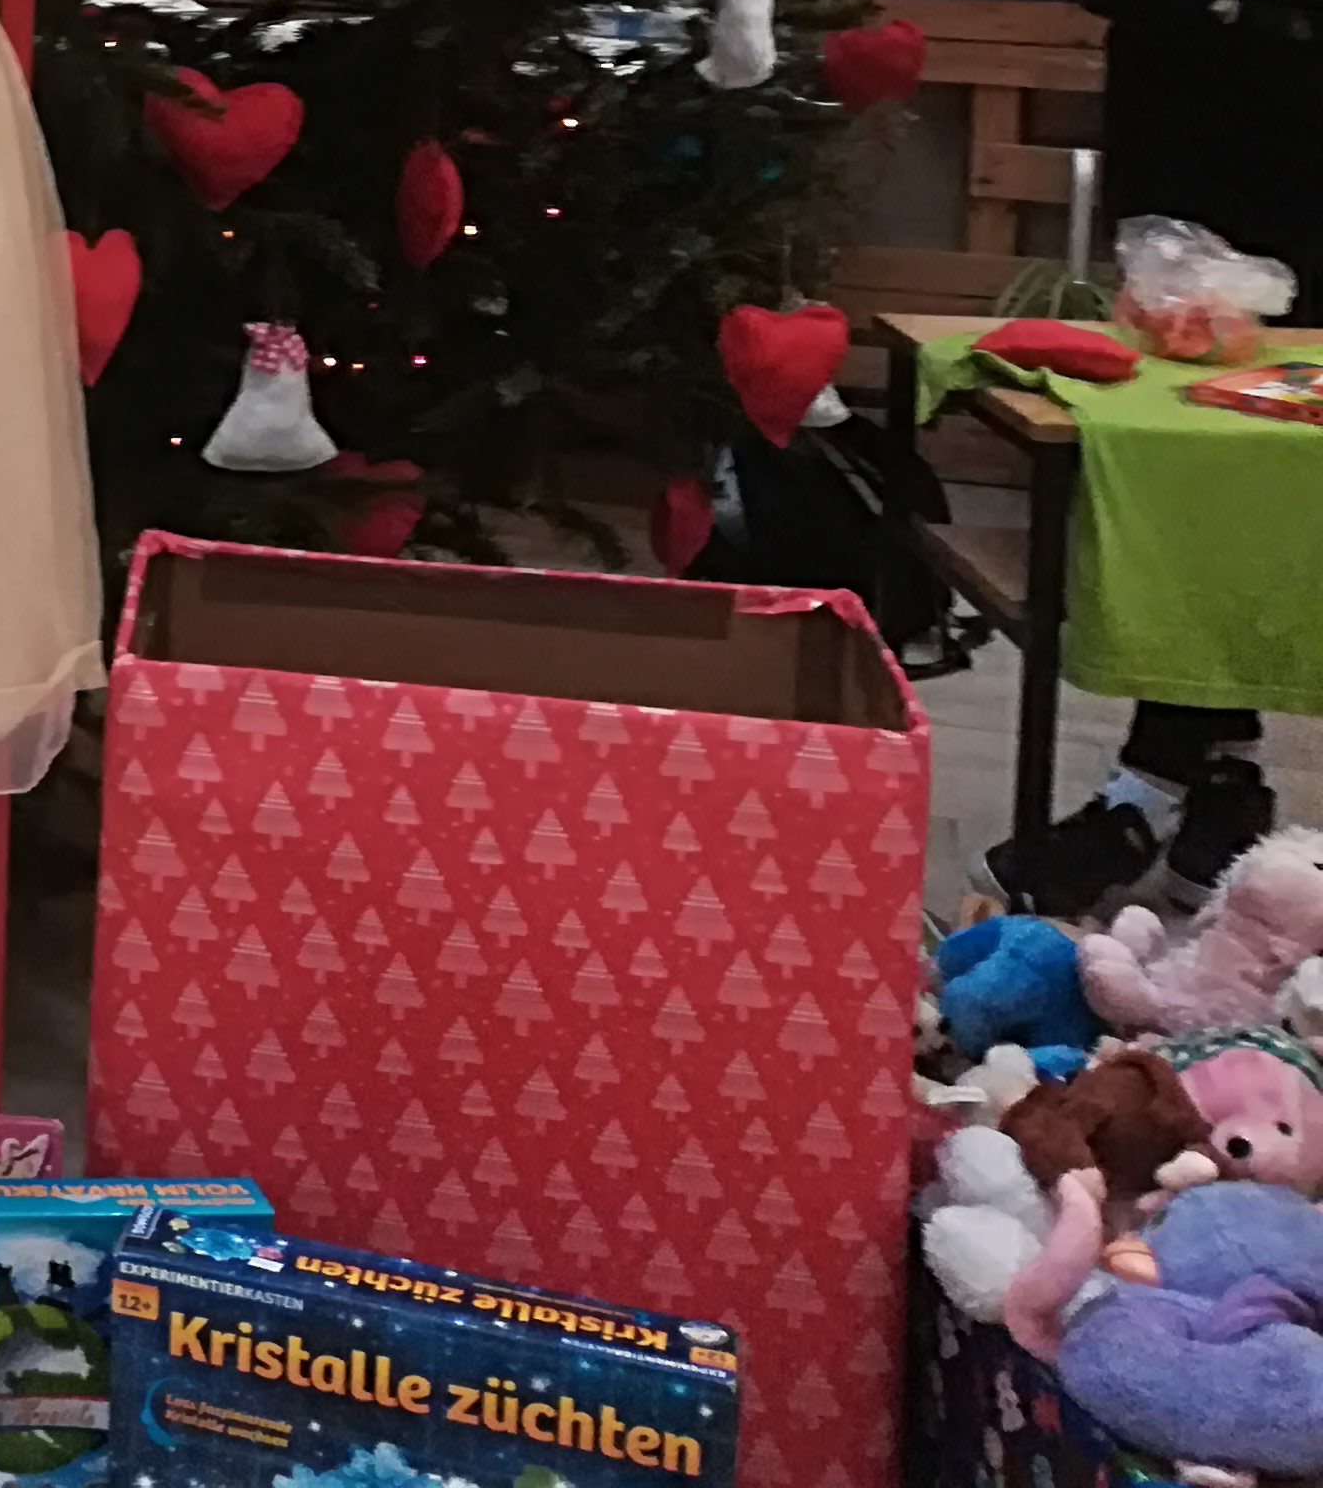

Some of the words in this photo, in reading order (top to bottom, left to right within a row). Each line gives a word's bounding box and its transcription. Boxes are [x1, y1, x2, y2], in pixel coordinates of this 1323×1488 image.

[118, 1261, 305, 1311] EXPERIMENTIERKASTEN
[118, 1294, 153, 1313] 12+
[296, 1254, 464, 1304] züchten
[472, 1292, 669, 1351] Kristalle
[168, 1310, 432, 1414] Kristalle
[446, 1376, 703, 1477] züchten
